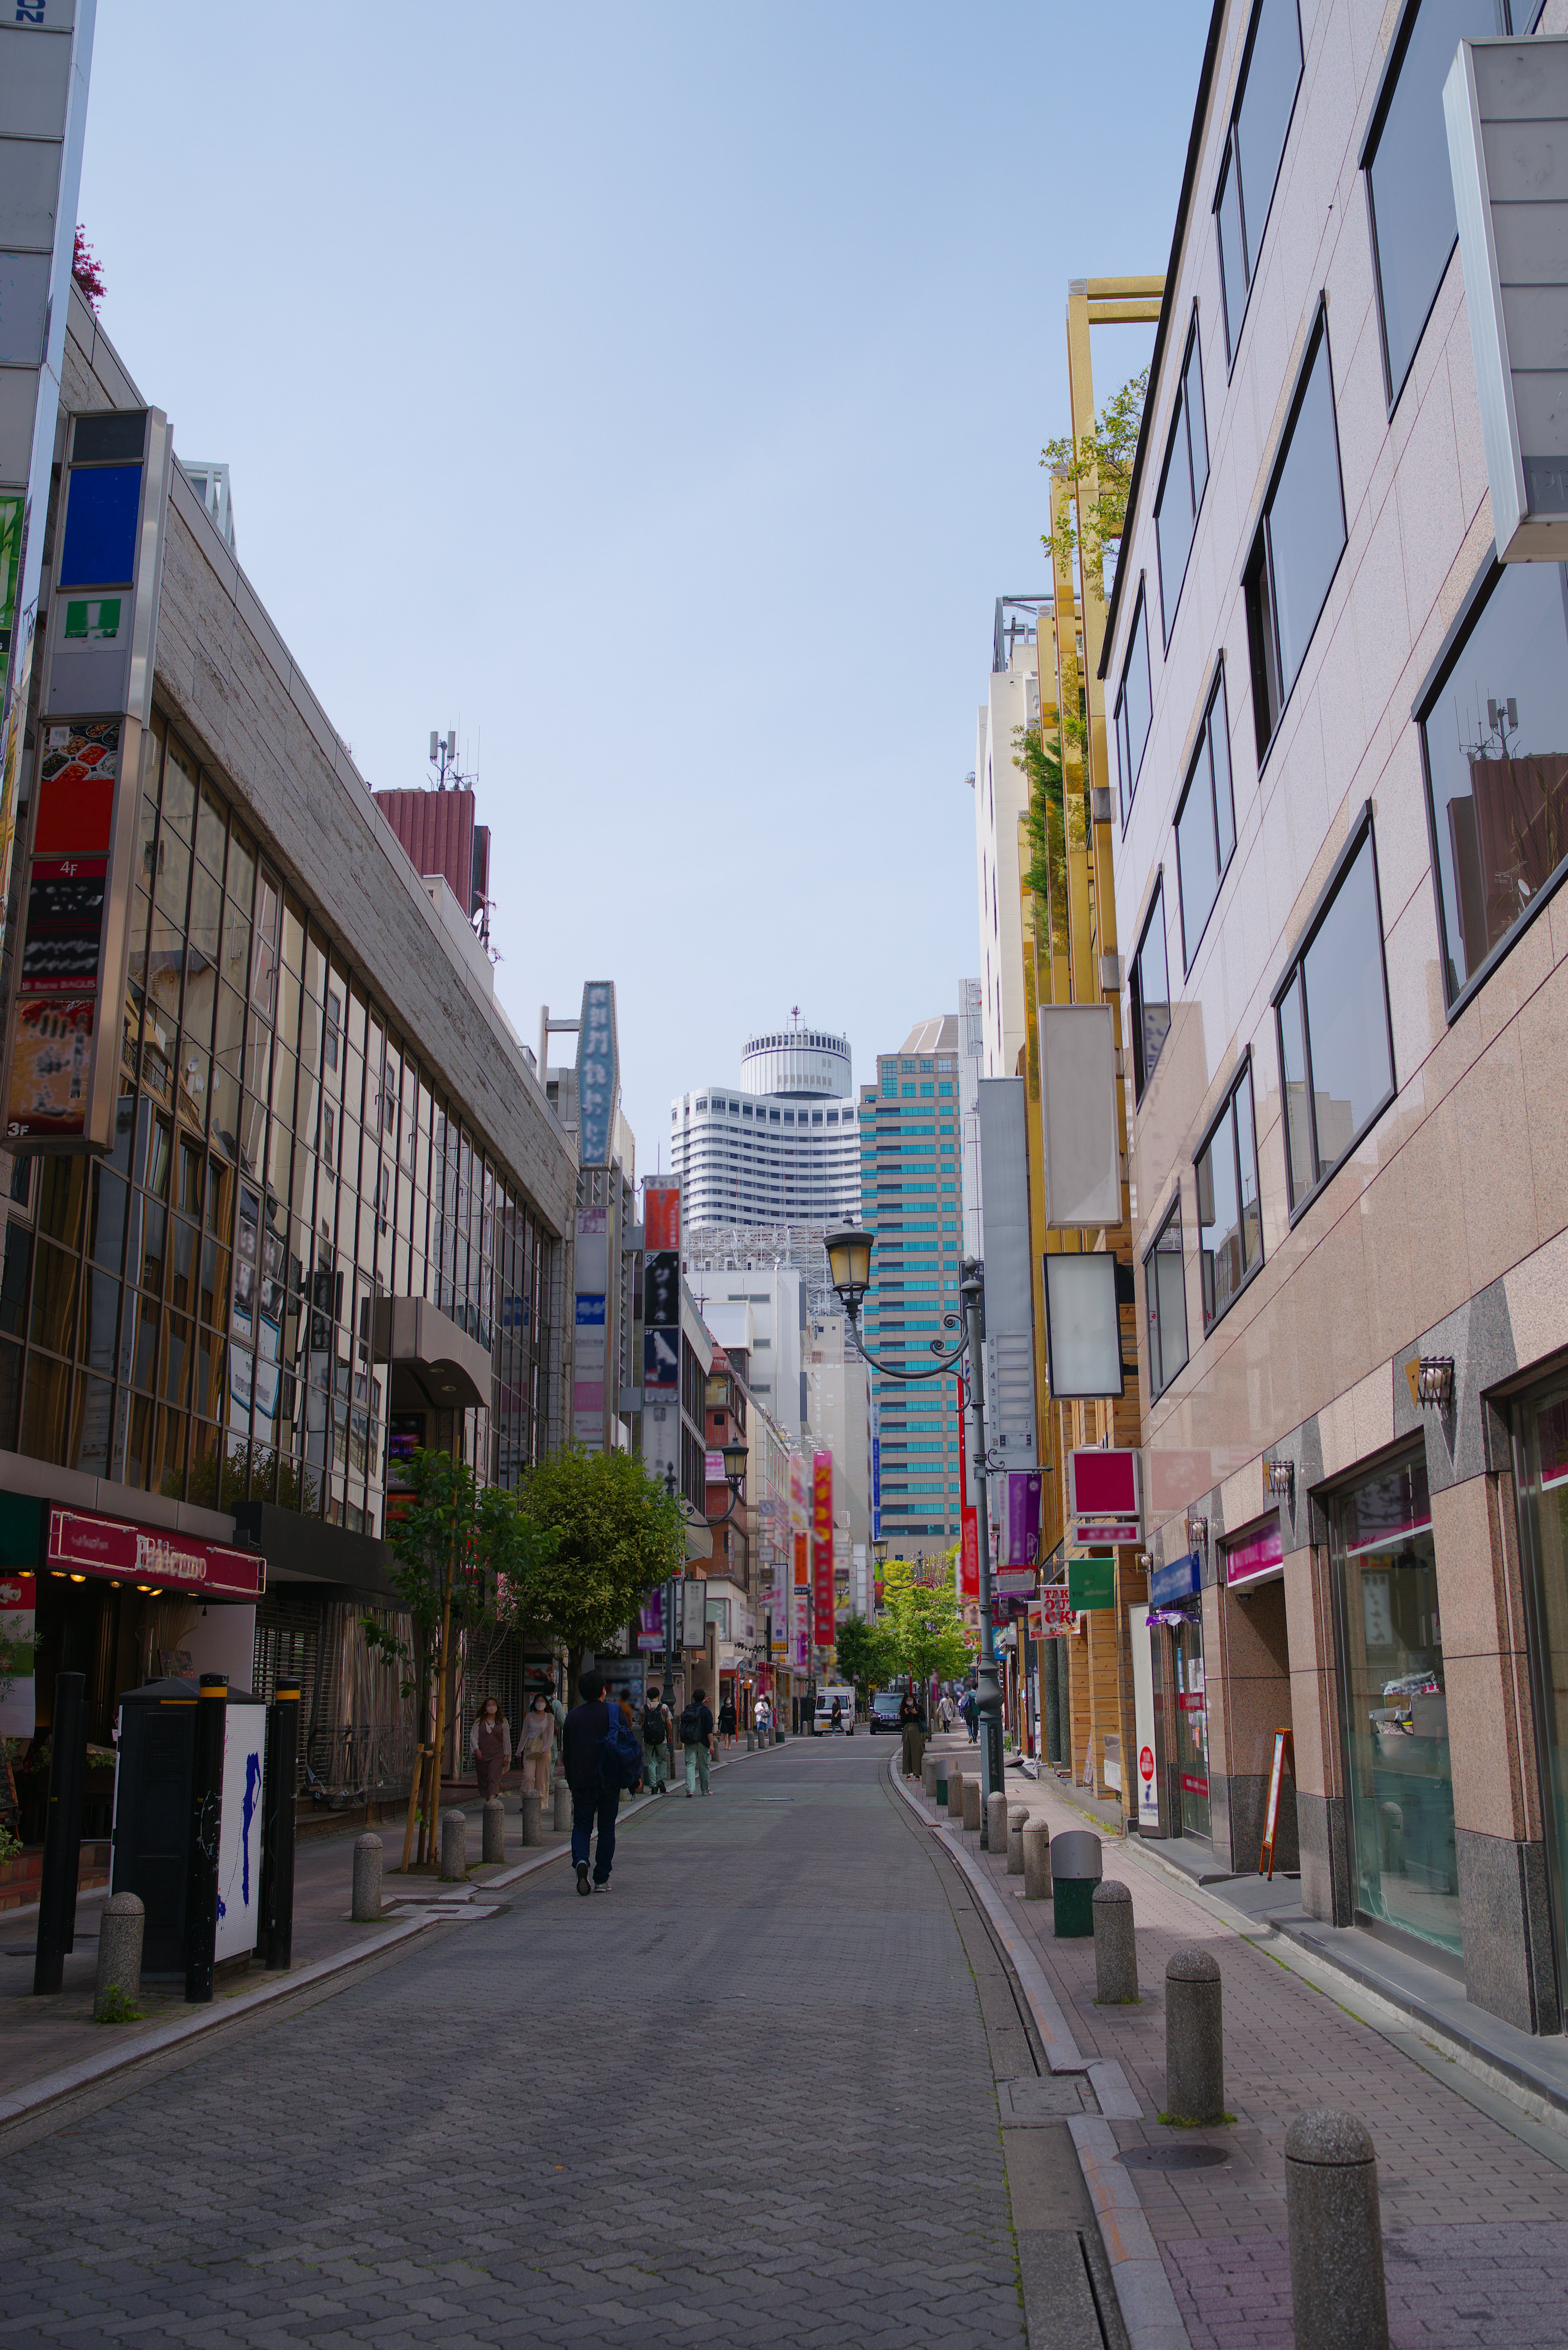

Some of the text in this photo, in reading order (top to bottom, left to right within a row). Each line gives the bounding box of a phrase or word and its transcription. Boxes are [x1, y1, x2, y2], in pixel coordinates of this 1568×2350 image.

[60, 861, 78, 876] 4F
[7, 1122, 29, 1136] 3F
[1044, 1590, 1069, 1599] TAK
